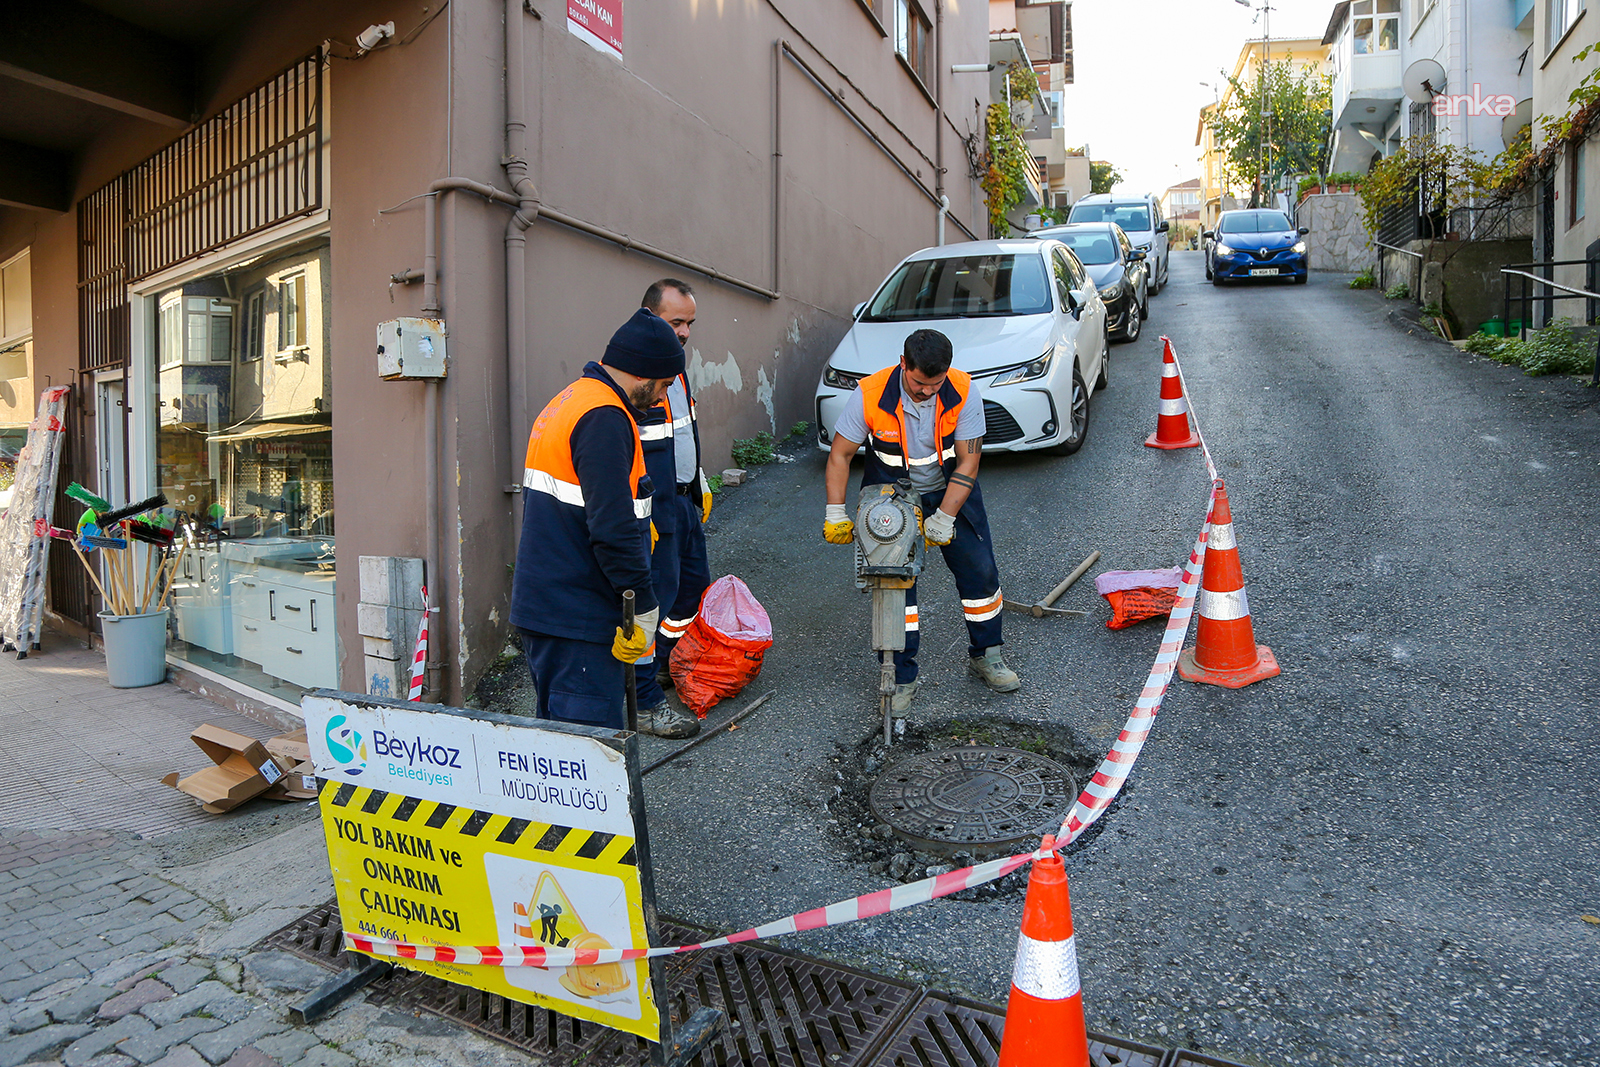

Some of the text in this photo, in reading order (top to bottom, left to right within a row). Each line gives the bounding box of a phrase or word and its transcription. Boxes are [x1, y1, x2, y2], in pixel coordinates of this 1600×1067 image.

[597, 4, 613, 27] KAN
[373, 730, 462, 769] Beykoz
[498, 751, 587, 781] FEN İŞLERİ
[388, 763, 453, 786] Belediyesi
[501, 778, 608, 812] MÜDÜRLÜĞÜ
[333, 816, 463, 868] YOL BAKIM ve
[363, 857, 443, 896] ONARIM
[360, 887, 462, 933] ÇALIŞMASI
[358, 920, 377, 936] 444
[380, 926, 400, 941] 666
